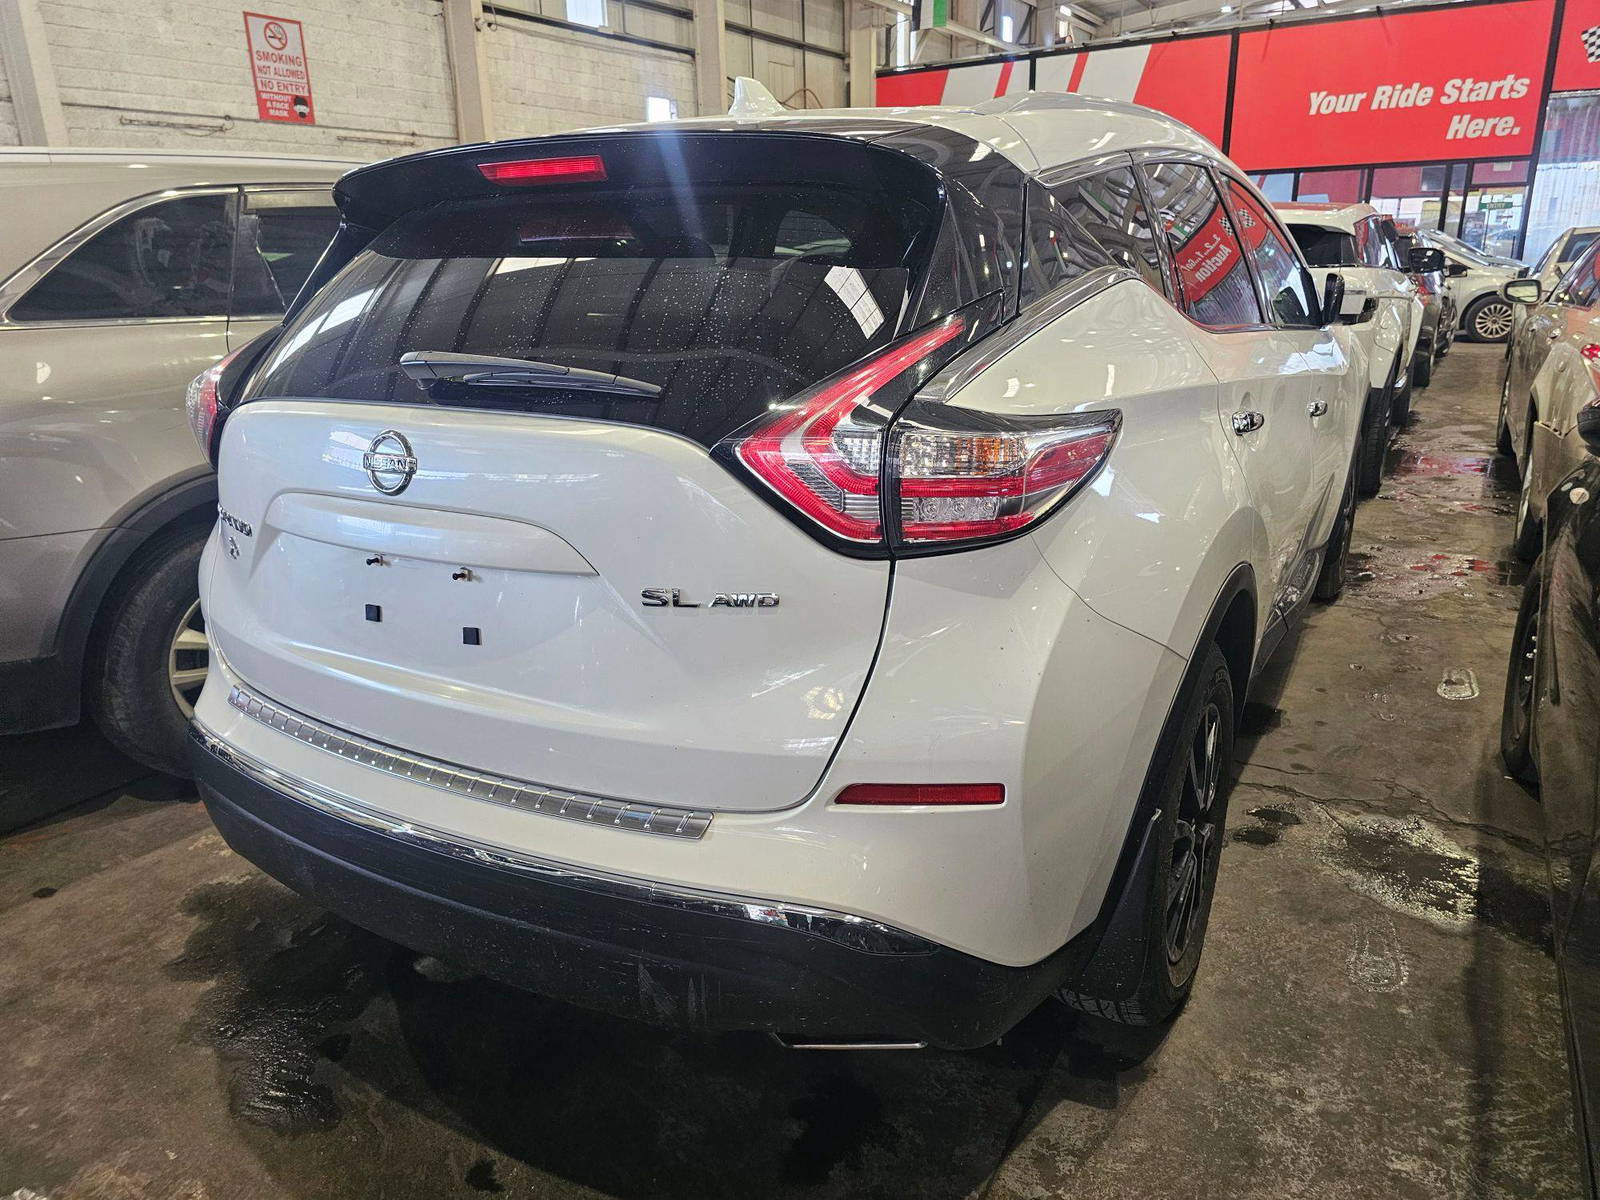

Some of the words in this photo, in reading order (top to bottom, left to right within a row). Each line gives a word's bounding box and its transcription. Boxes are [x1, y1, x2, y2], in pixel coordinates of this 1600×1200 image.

[255, 50, 303, 67] SMOKING
[257, 65, 272, 75] NOT
[274, 67, 305, 80] ALLOWED
[260, 79, 274, 90] NO
[277, 81, 306, 94] ENTRY
[1308, 90, 1367, 116] Your
[1370, 83, 1434, 111] Ride
[1440, 74, 1531, 105] Starts
[1446, 114, 1521, 140] Here.
[363, 454, 408, 471] NISSAN
[640, 587, 700, 607] SL
[708, 592, 780, 608] AWD
